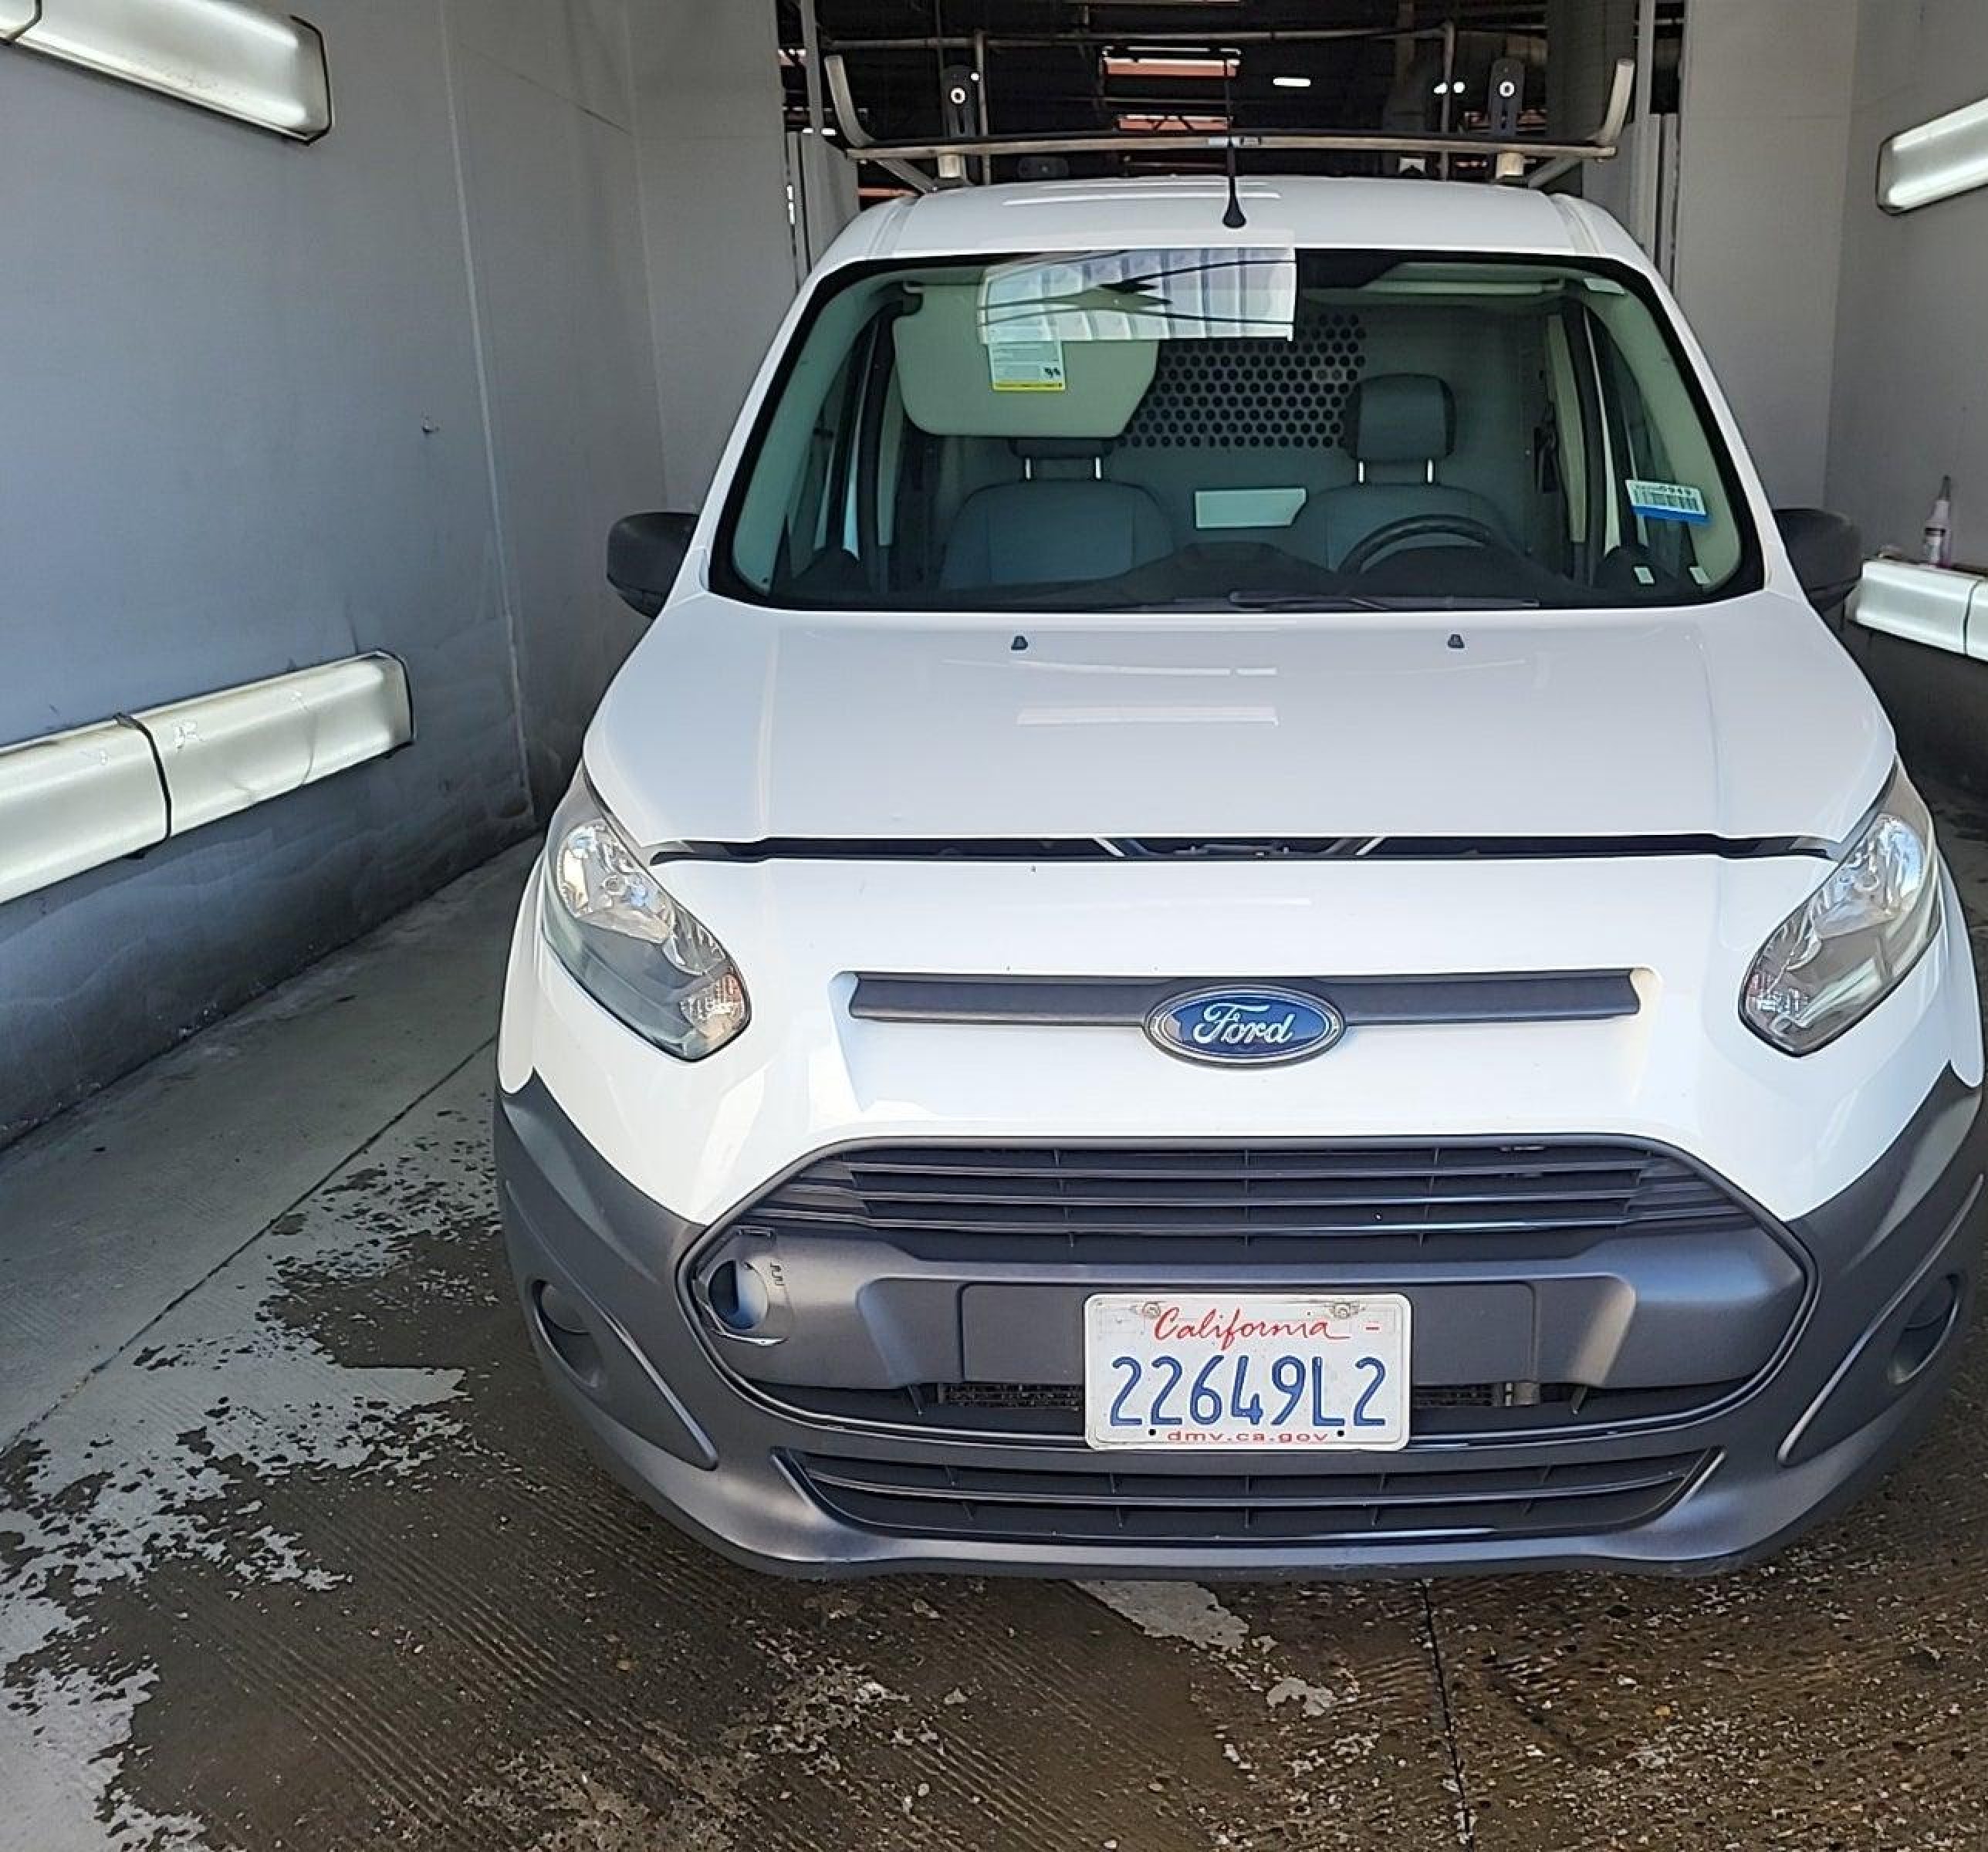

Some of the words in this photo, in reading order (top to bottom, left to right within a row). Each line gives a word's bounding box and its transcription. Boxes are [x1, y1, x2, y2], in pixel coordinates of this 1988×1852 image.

[1192, 1002, 1296, 1043] Ford
[1154, 1306, 1351, 1350] California
[1110, 1355, 1387, 1426] 22649L2
[1167, 1430, 1329, 1443] dmv.ca.gov
